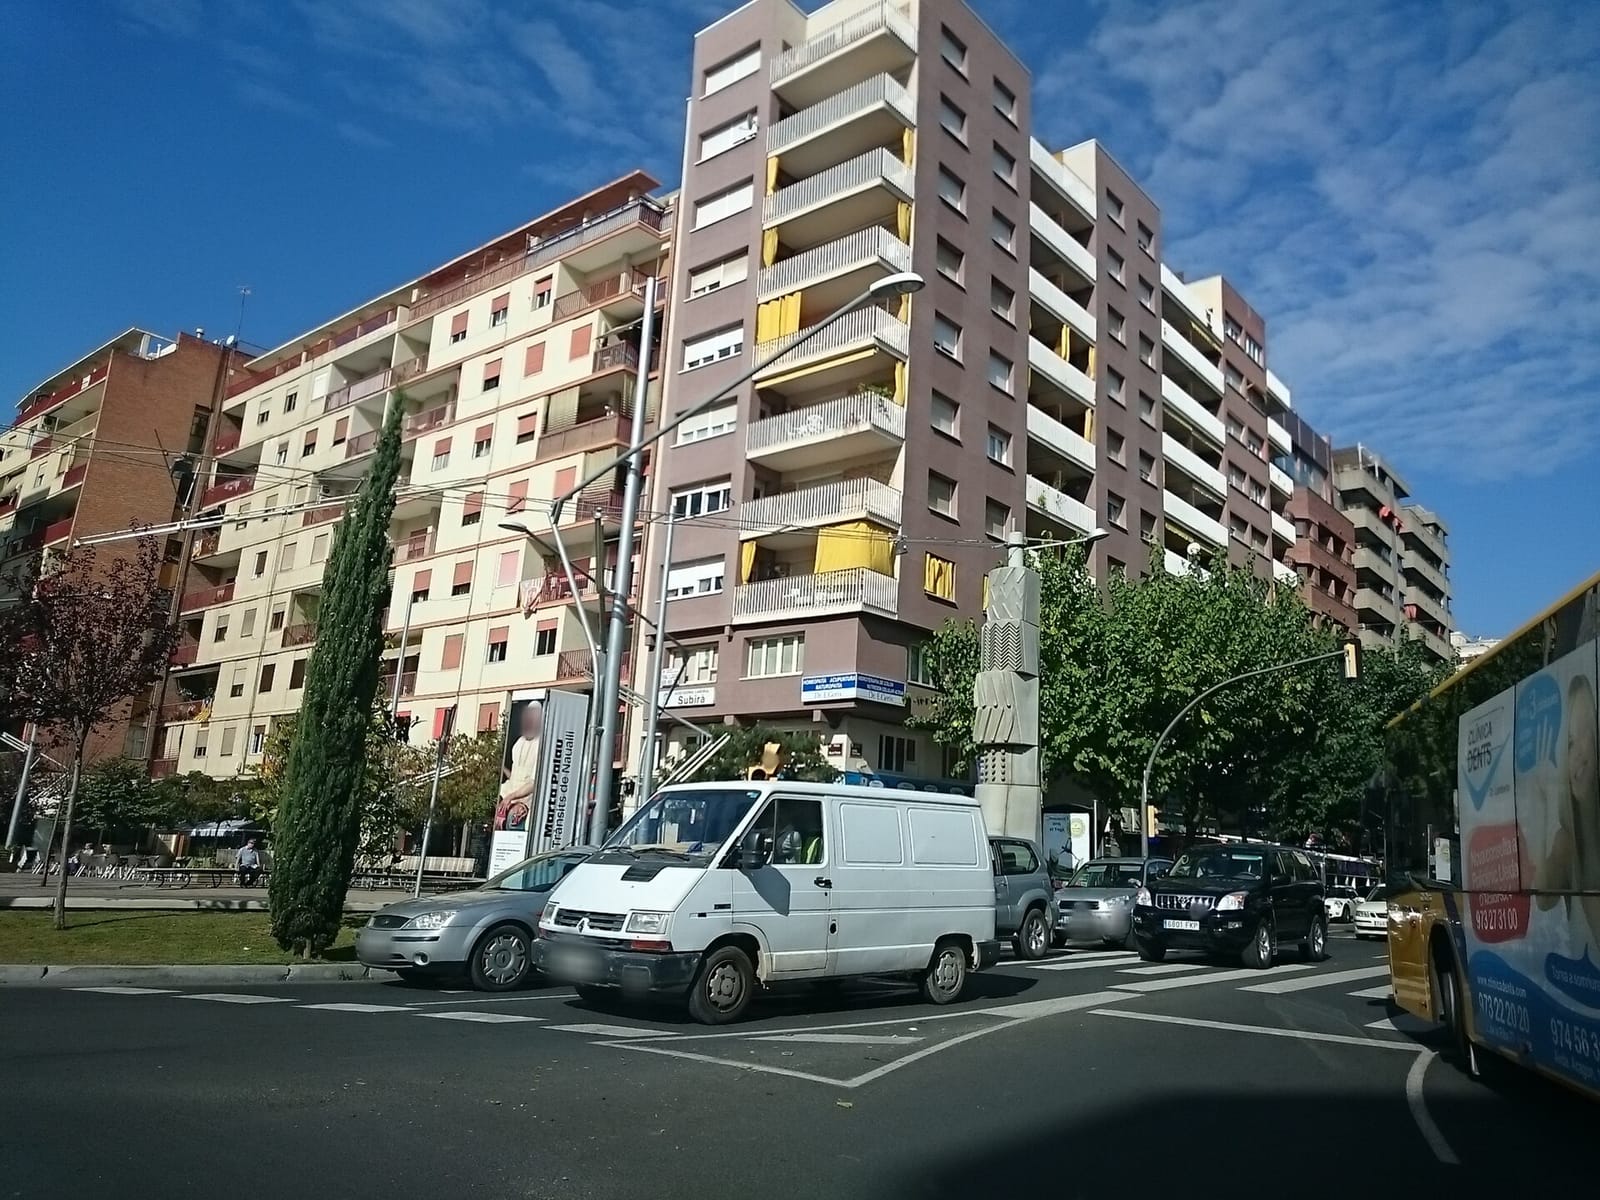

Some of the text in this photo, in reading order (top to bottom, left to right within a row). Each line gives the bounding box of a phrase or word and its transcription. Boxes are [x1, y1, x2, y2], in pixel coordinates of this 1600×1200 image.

[561, 731, 575, 774] Naualli
[1467, 742, 1492, 773] DENTS
[544, 738, 564, 838] Marta Palau
[560, 776, 569, 793] de
[1550, 1017, 1572, 1051] 974
